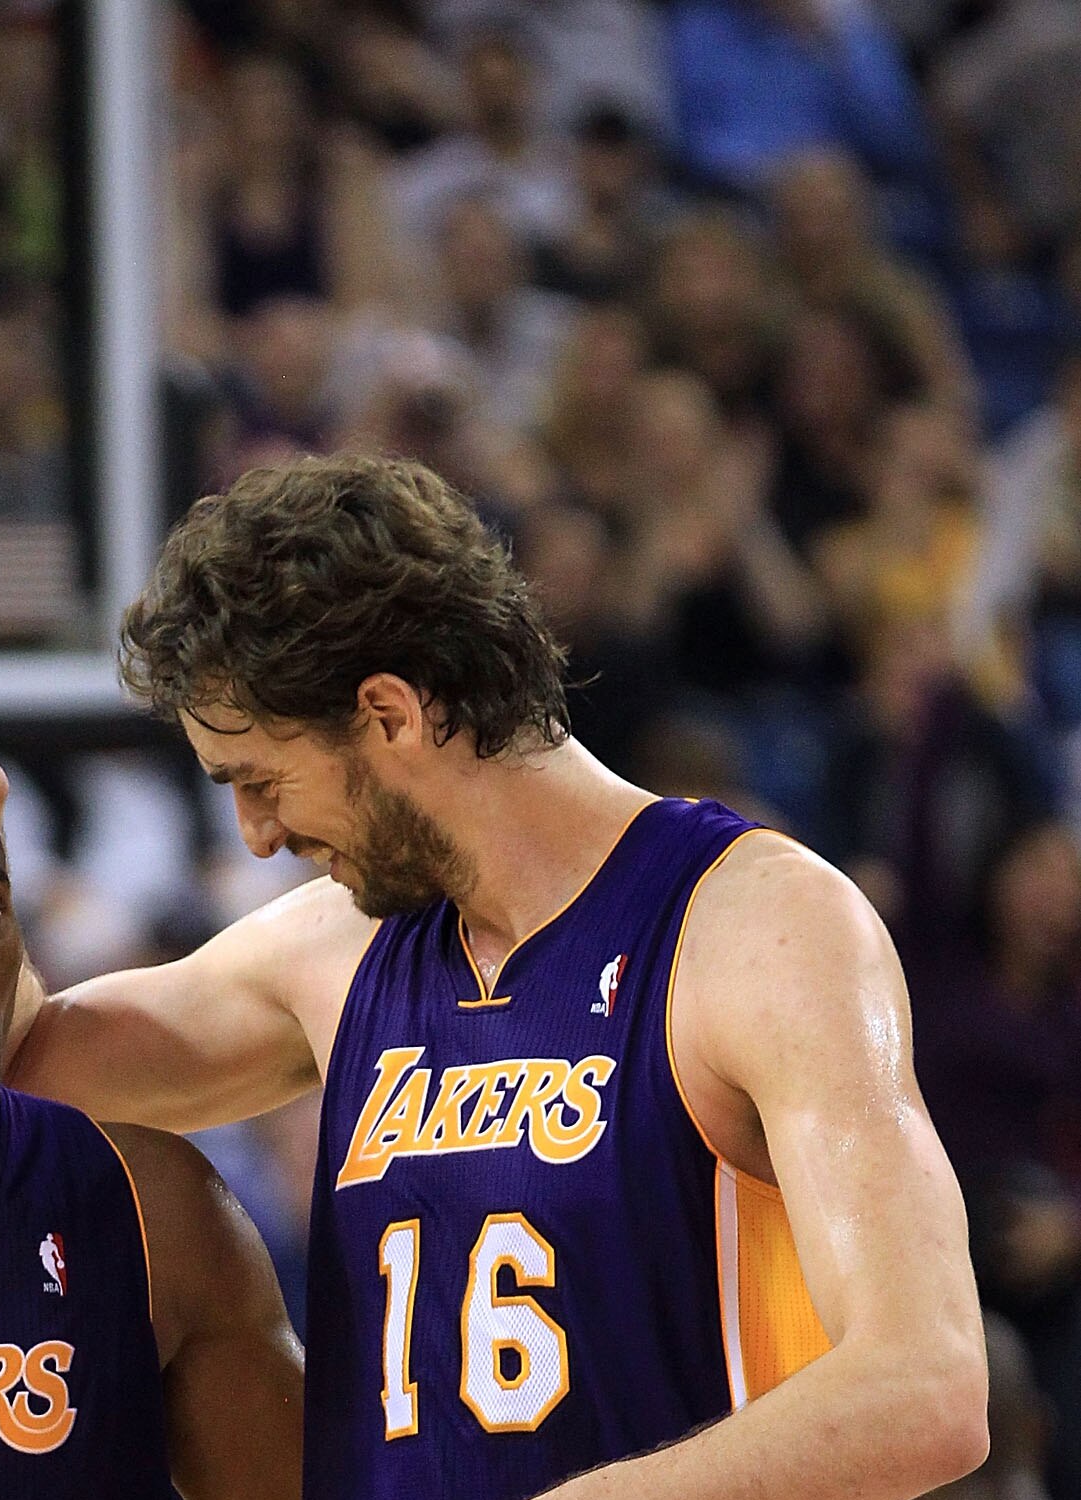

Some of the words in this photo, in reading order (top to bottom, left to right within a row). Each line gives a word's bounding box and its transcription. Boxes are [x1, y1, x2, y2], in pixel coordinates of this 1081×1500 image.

[590, 1002, 606, 1014] NBA
[335, 1046, 616, 1191] LAKERS
[43, 1281, 60, 1294] NBA
[379, 1212, 570, 1442] 16
